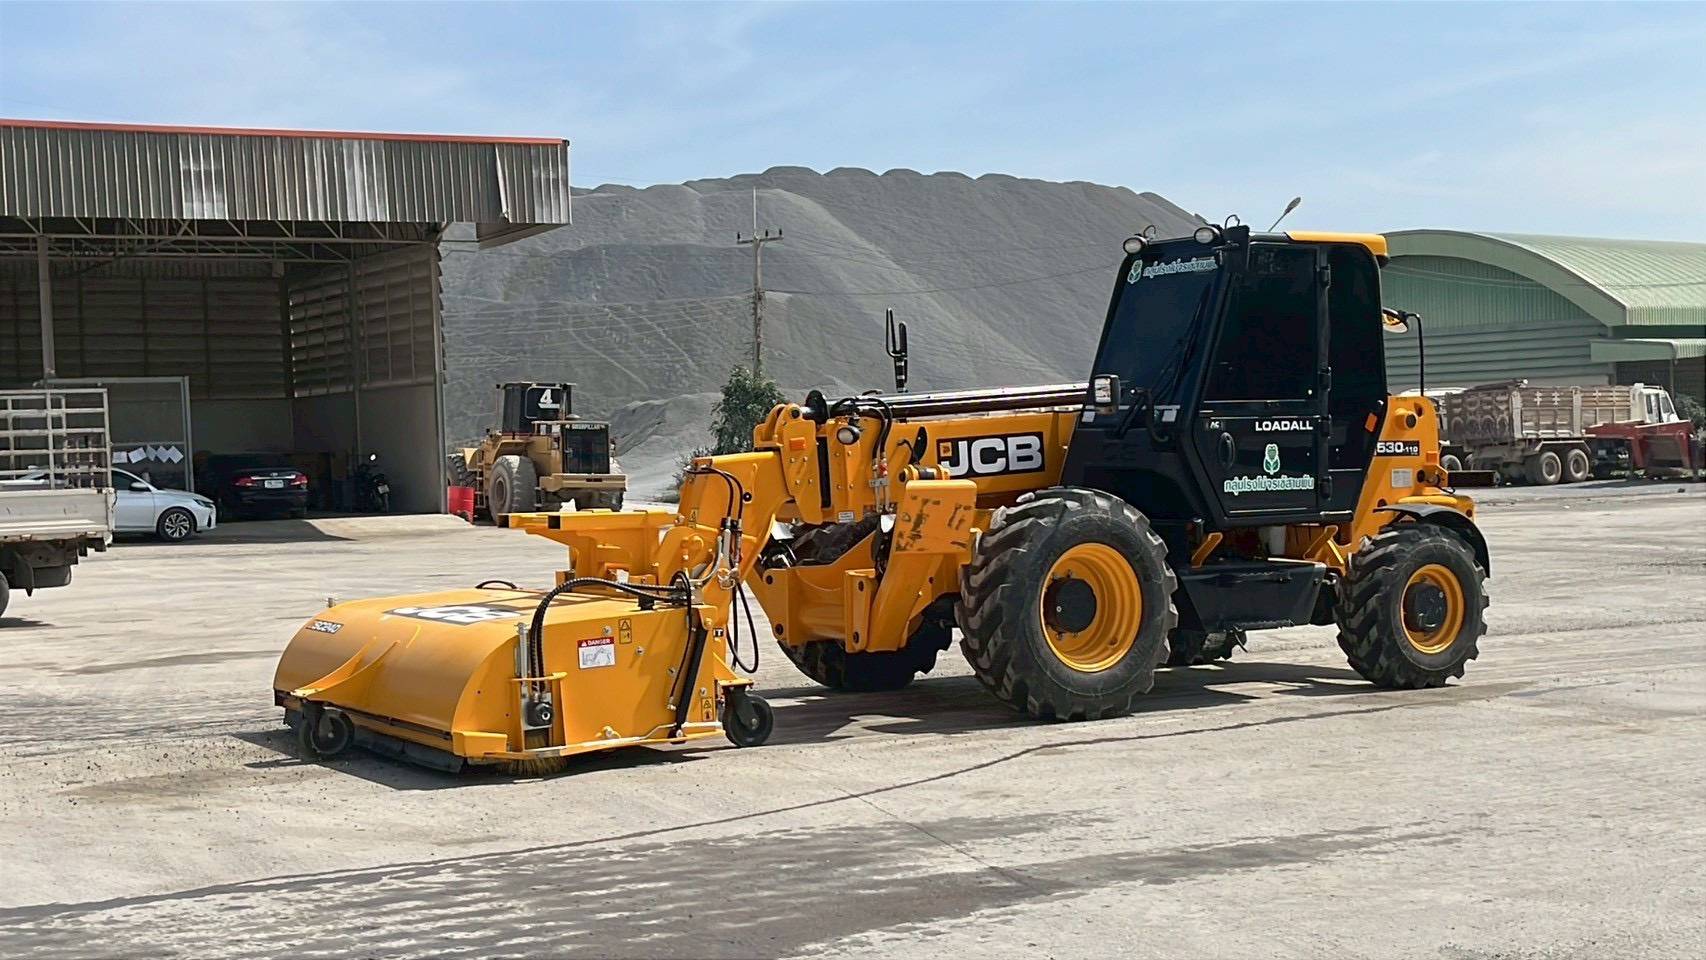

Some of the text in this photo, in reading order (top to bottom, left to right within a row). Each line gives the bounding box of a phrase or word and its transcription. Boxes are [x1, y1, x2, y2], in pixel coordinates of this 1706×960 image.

[539, 388, 553, 405] 4
[1255, 420, 1313, 431] LOADALL
[1376, 441, 1418, 453] 530-110
[940, 435, 1043, 476] JCB
[587, 638, 611, 646] DANGER
